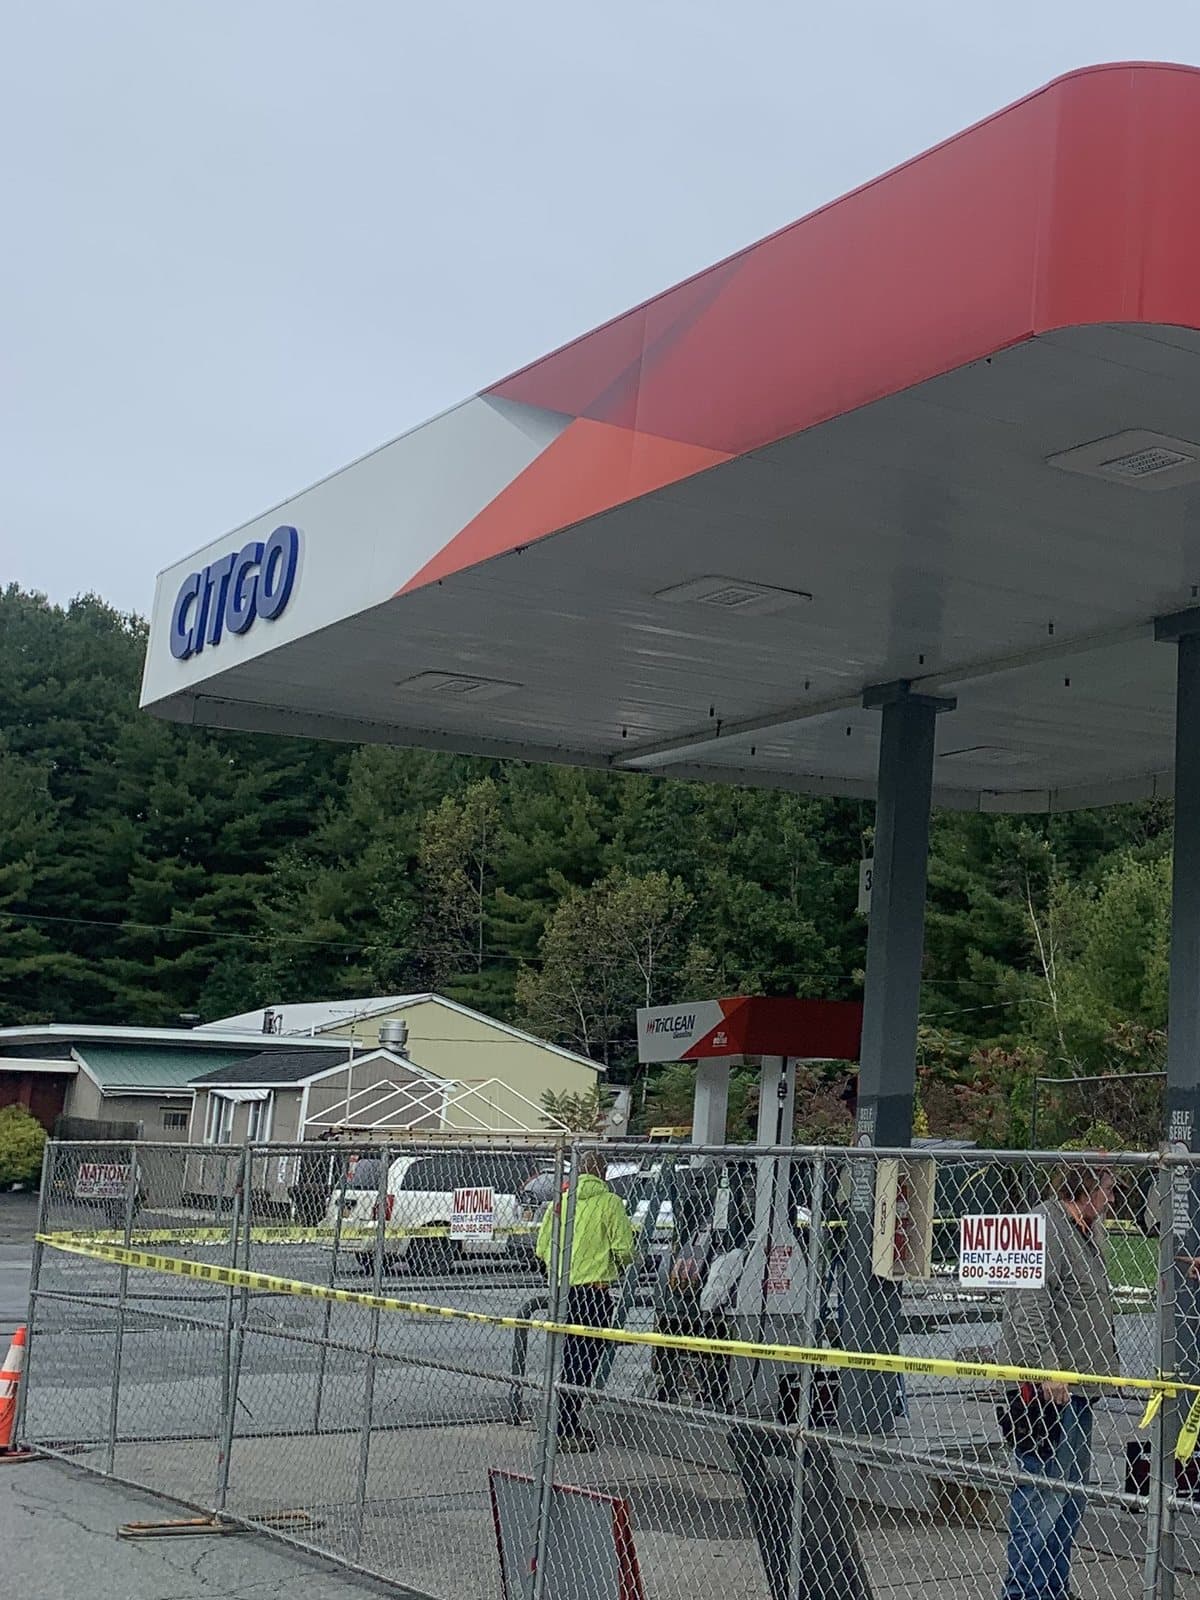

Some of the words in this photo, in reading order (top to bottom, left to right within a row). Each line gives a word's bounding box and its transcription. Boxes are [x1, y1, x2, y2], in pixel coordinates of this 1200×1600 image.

[170, 525, 299, 660] CITGO
[865, 870, 872, 891] 3
[654, 1014, 696, 1033] TriCLEAN
[860, 1107, 873, 1120] SELF
[1171, 1110, 1190, 1124] SELF
[857, 1120, 875, 1133] SERVE
[1168, 1125, 1193, 1141] SERVE
[80, 1165, 130, 1181] NATION
[453, 1189, 493, 1213] NATIONAL
[962, 1217, 1043, 1251] NATIONAL
[962, 1252, 1044, 1264] RENT-A-FENCE
[961, 1266, 1042, 1279] 800-352-5675
